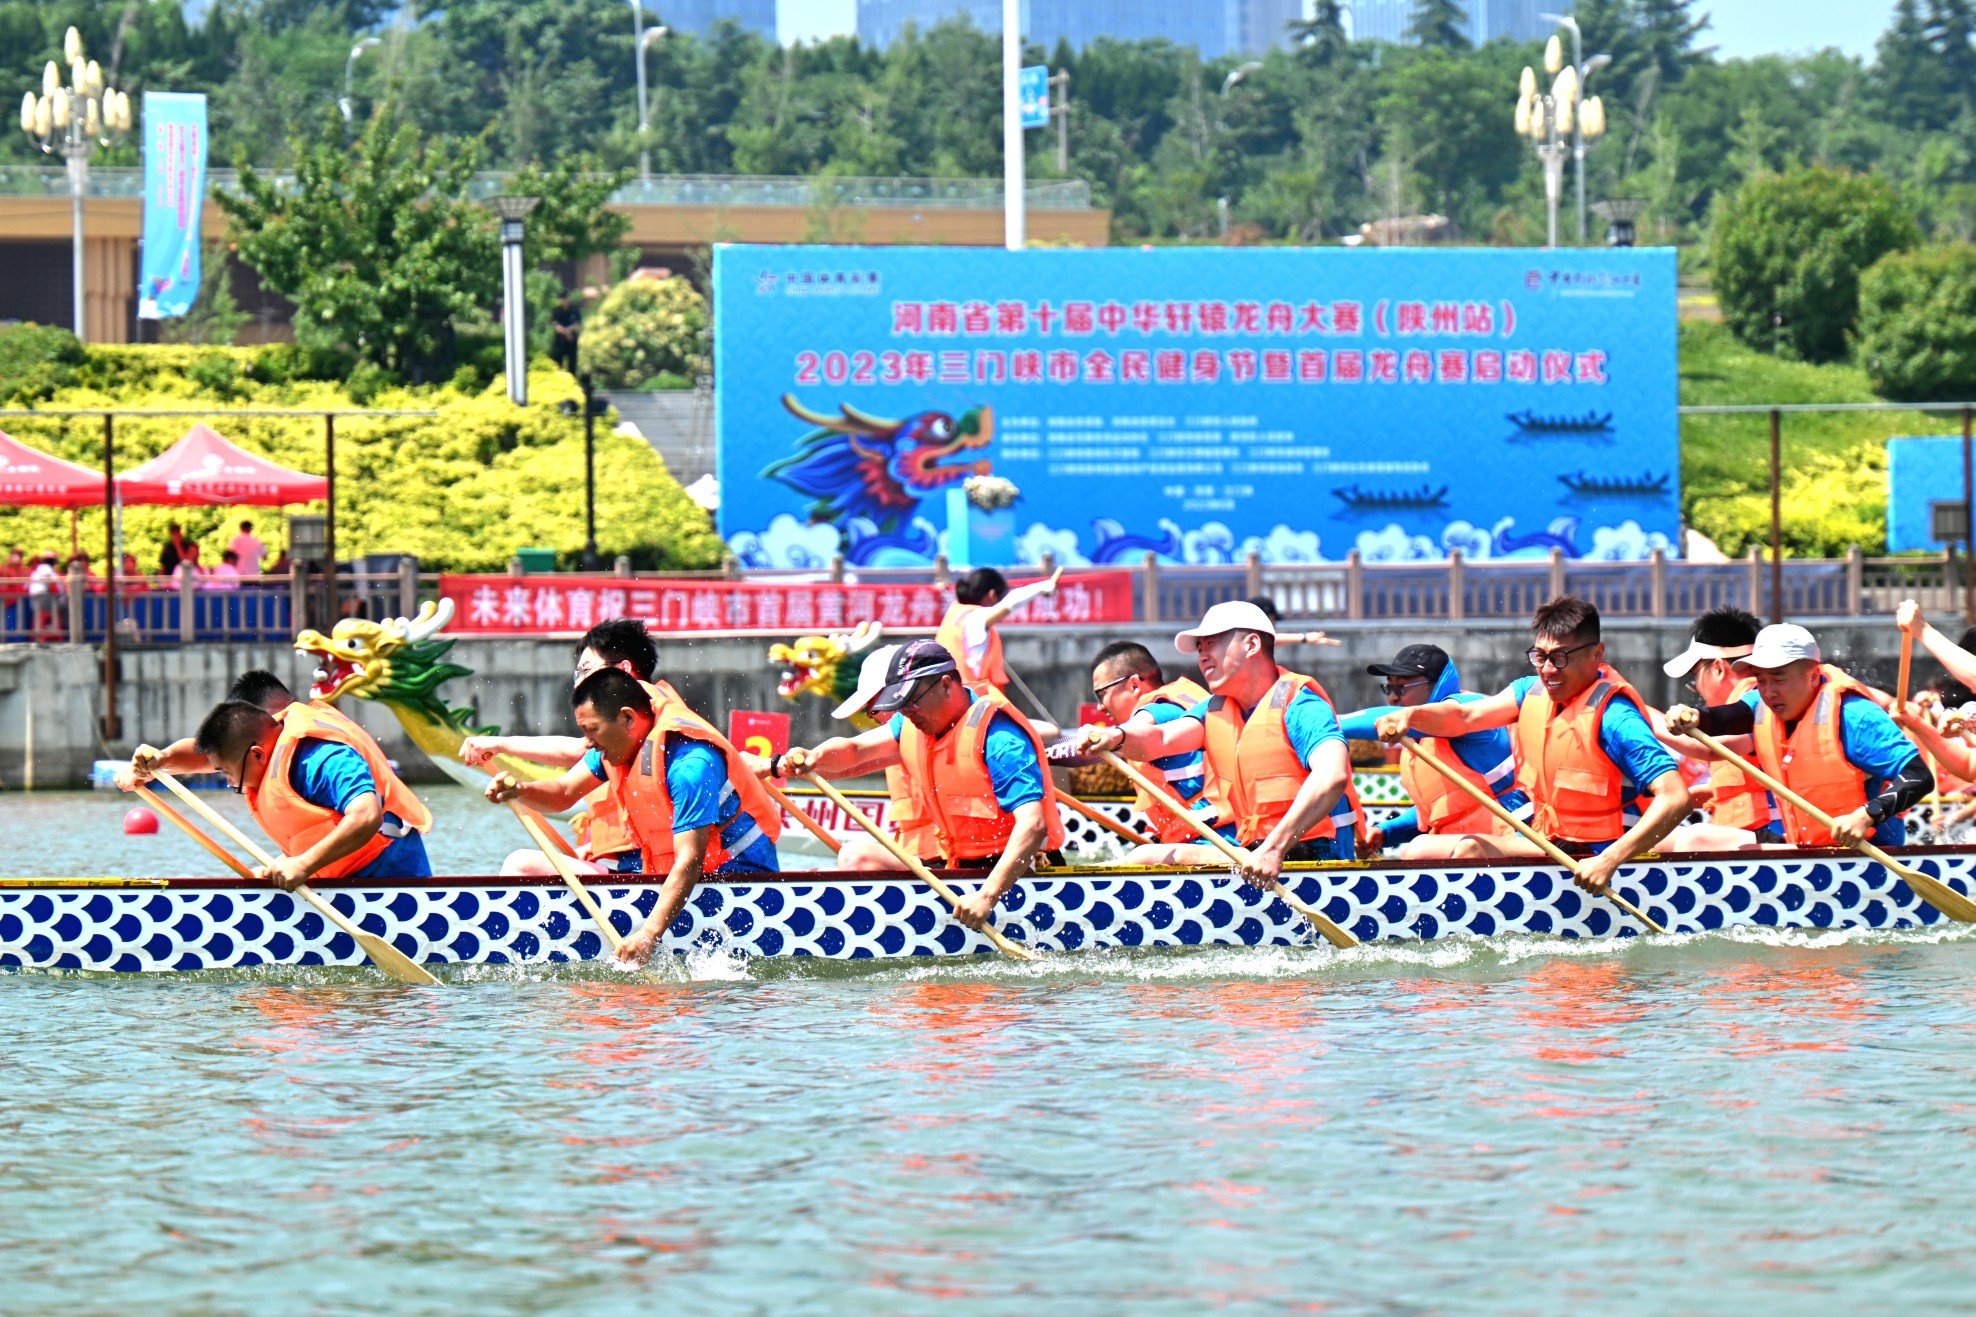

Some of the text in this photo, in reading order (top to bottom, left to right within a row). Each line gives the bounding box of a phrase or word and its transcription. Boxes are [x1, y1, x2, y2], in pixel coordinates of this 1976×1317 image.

[796, 351, 1607, 383] 2023年三门峡市全民健身节暨首届龙舟赛启动仪式
